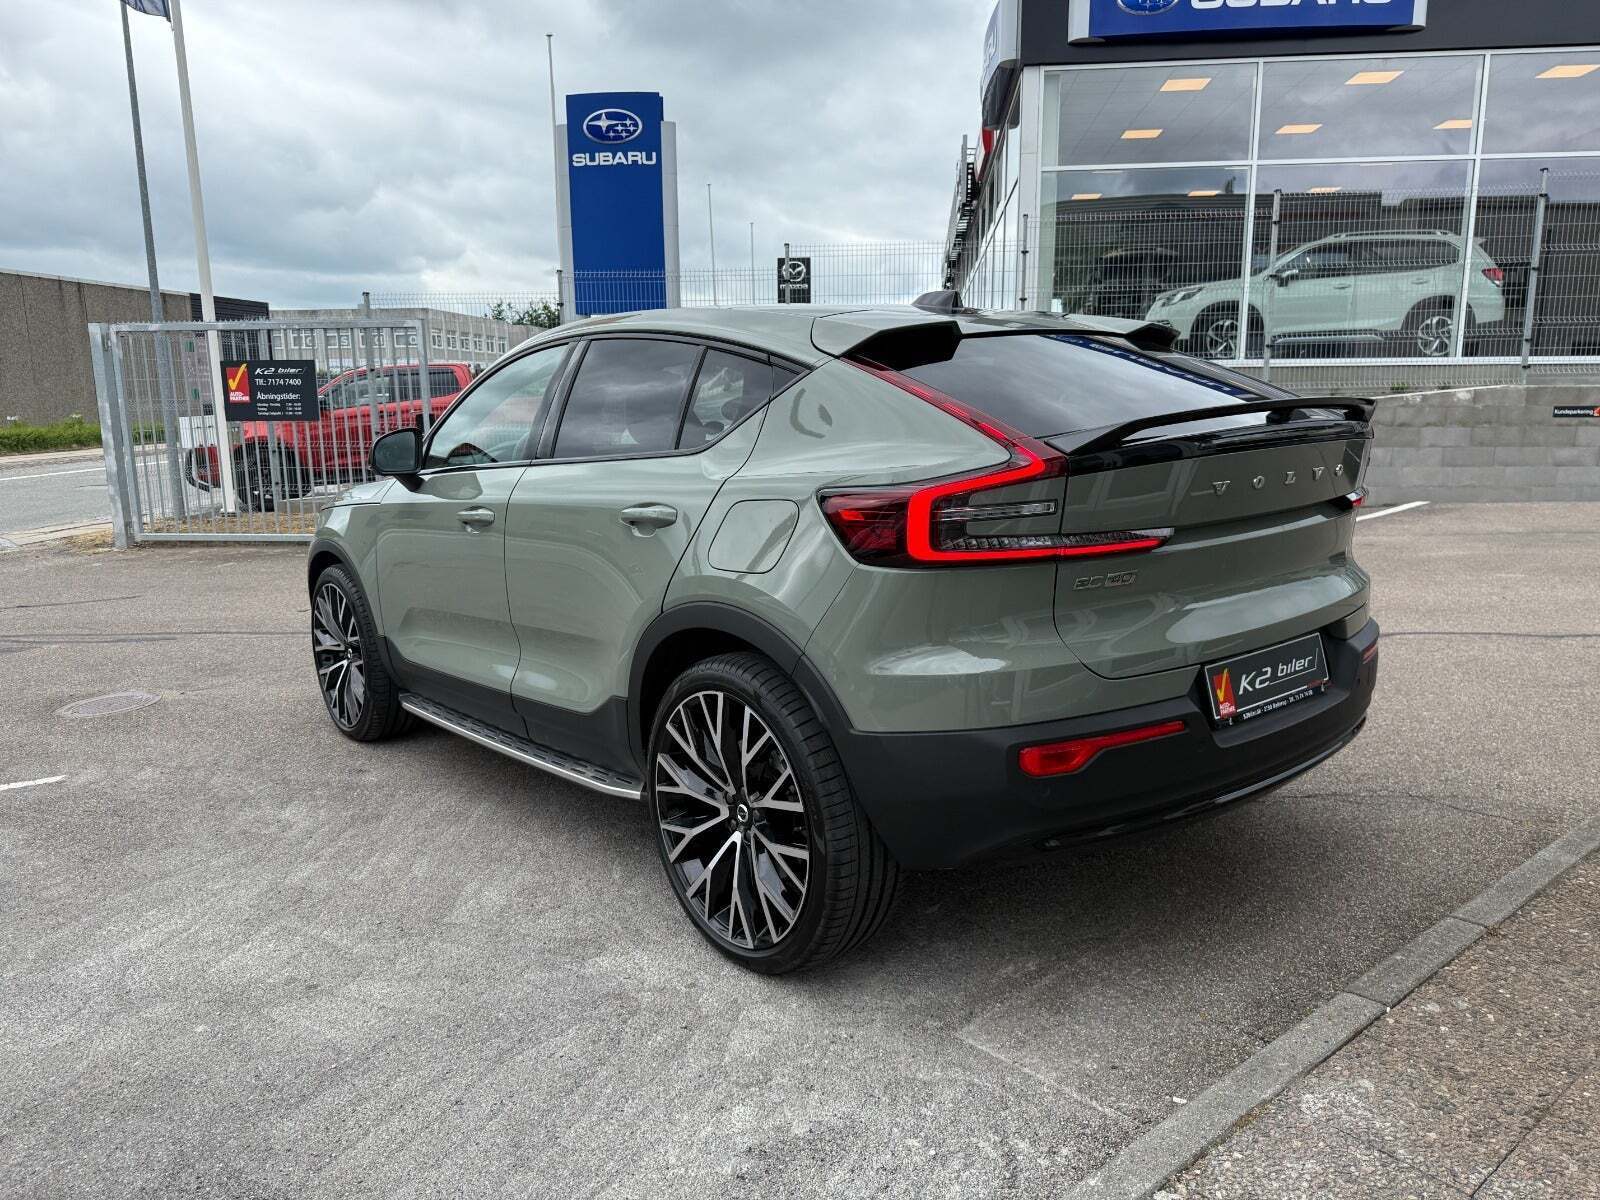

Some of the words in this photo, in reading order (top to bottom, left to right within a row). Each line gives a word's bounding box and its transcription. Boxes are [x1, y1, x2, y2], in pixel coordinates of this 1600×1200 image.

[572, 151, 656, 167] SUBARU
[254, 367, 276, 375] K2
[267, 378, 284, 386] 7174
[285, 378, 302, 386] 7400
[256, 391, 301, 401] Åbningstider:
[1212, 463, 1344, 496] VOLVO
[1238, 666, 1272, 695] K2
[1277, 656, 1313, 677] biler
